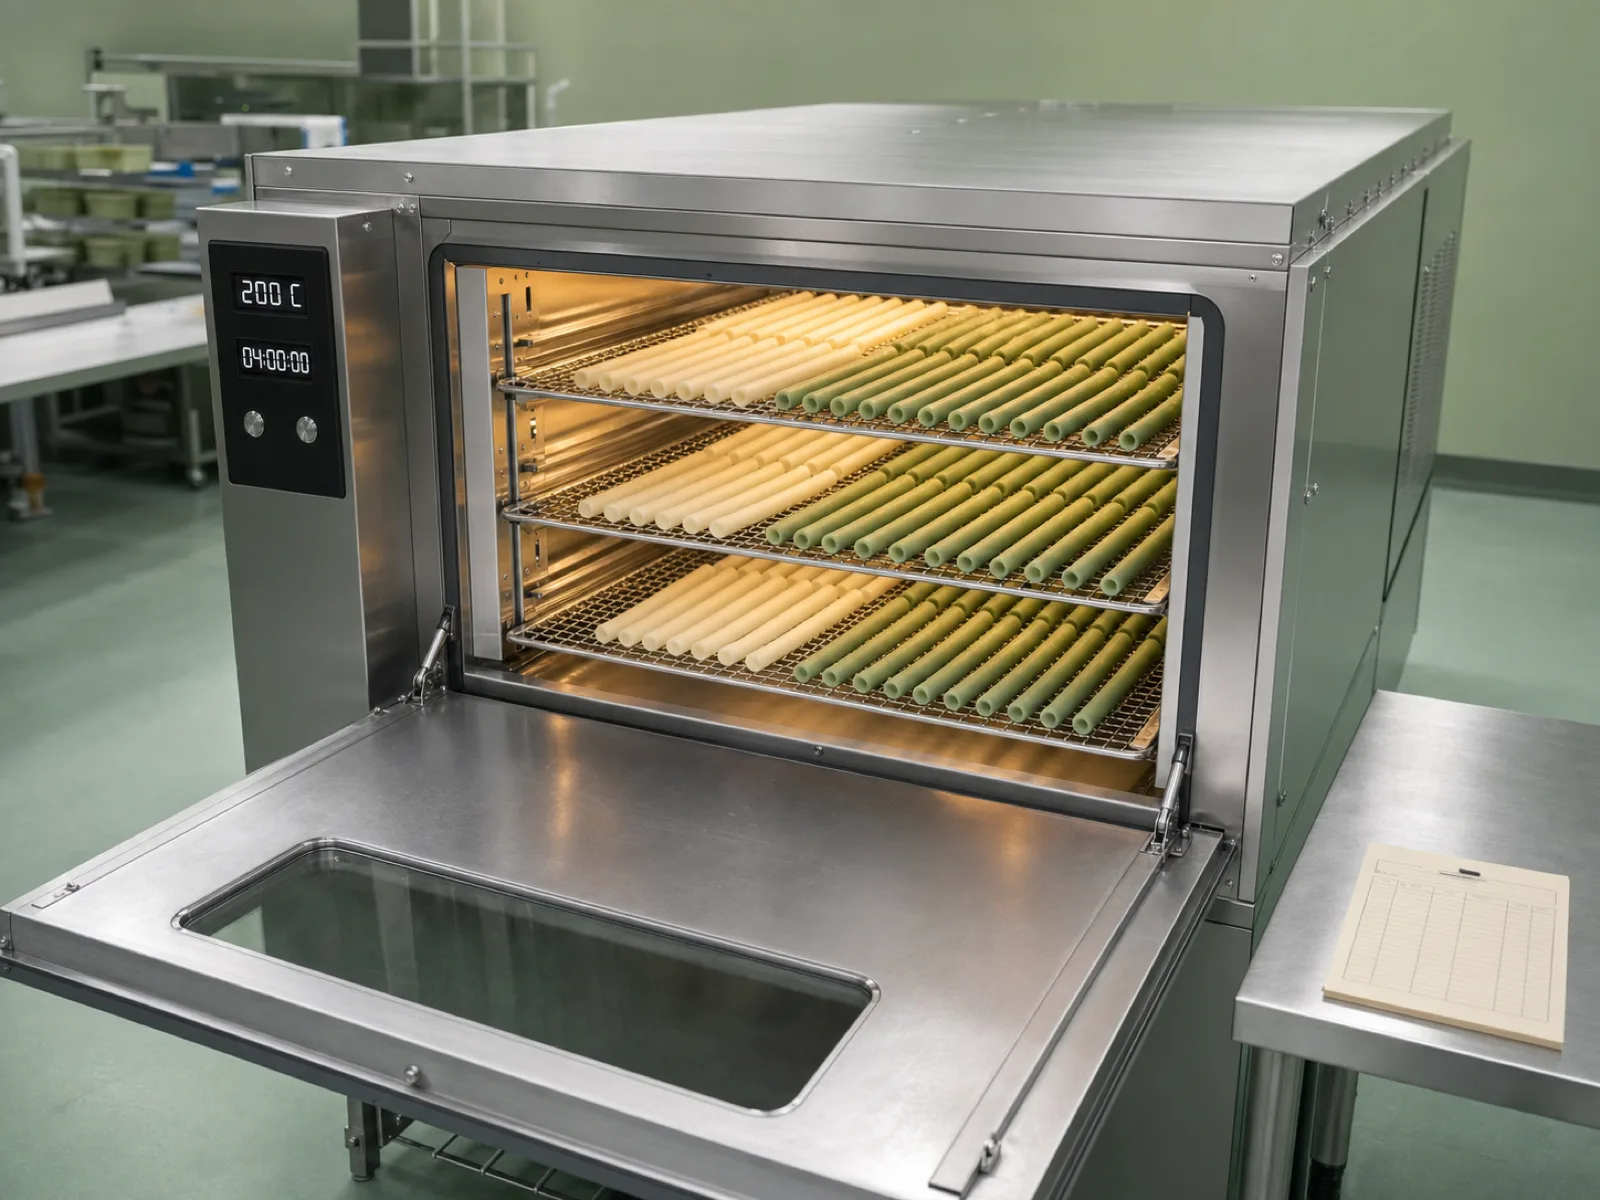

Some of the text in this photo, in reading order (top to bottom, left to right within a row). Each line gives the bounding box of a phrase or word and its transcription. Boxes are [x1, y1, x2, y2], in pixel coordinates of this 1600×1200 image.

[242, 280, 302, 307] 200 C
[242, 346, 310, 374] 04:00:00
